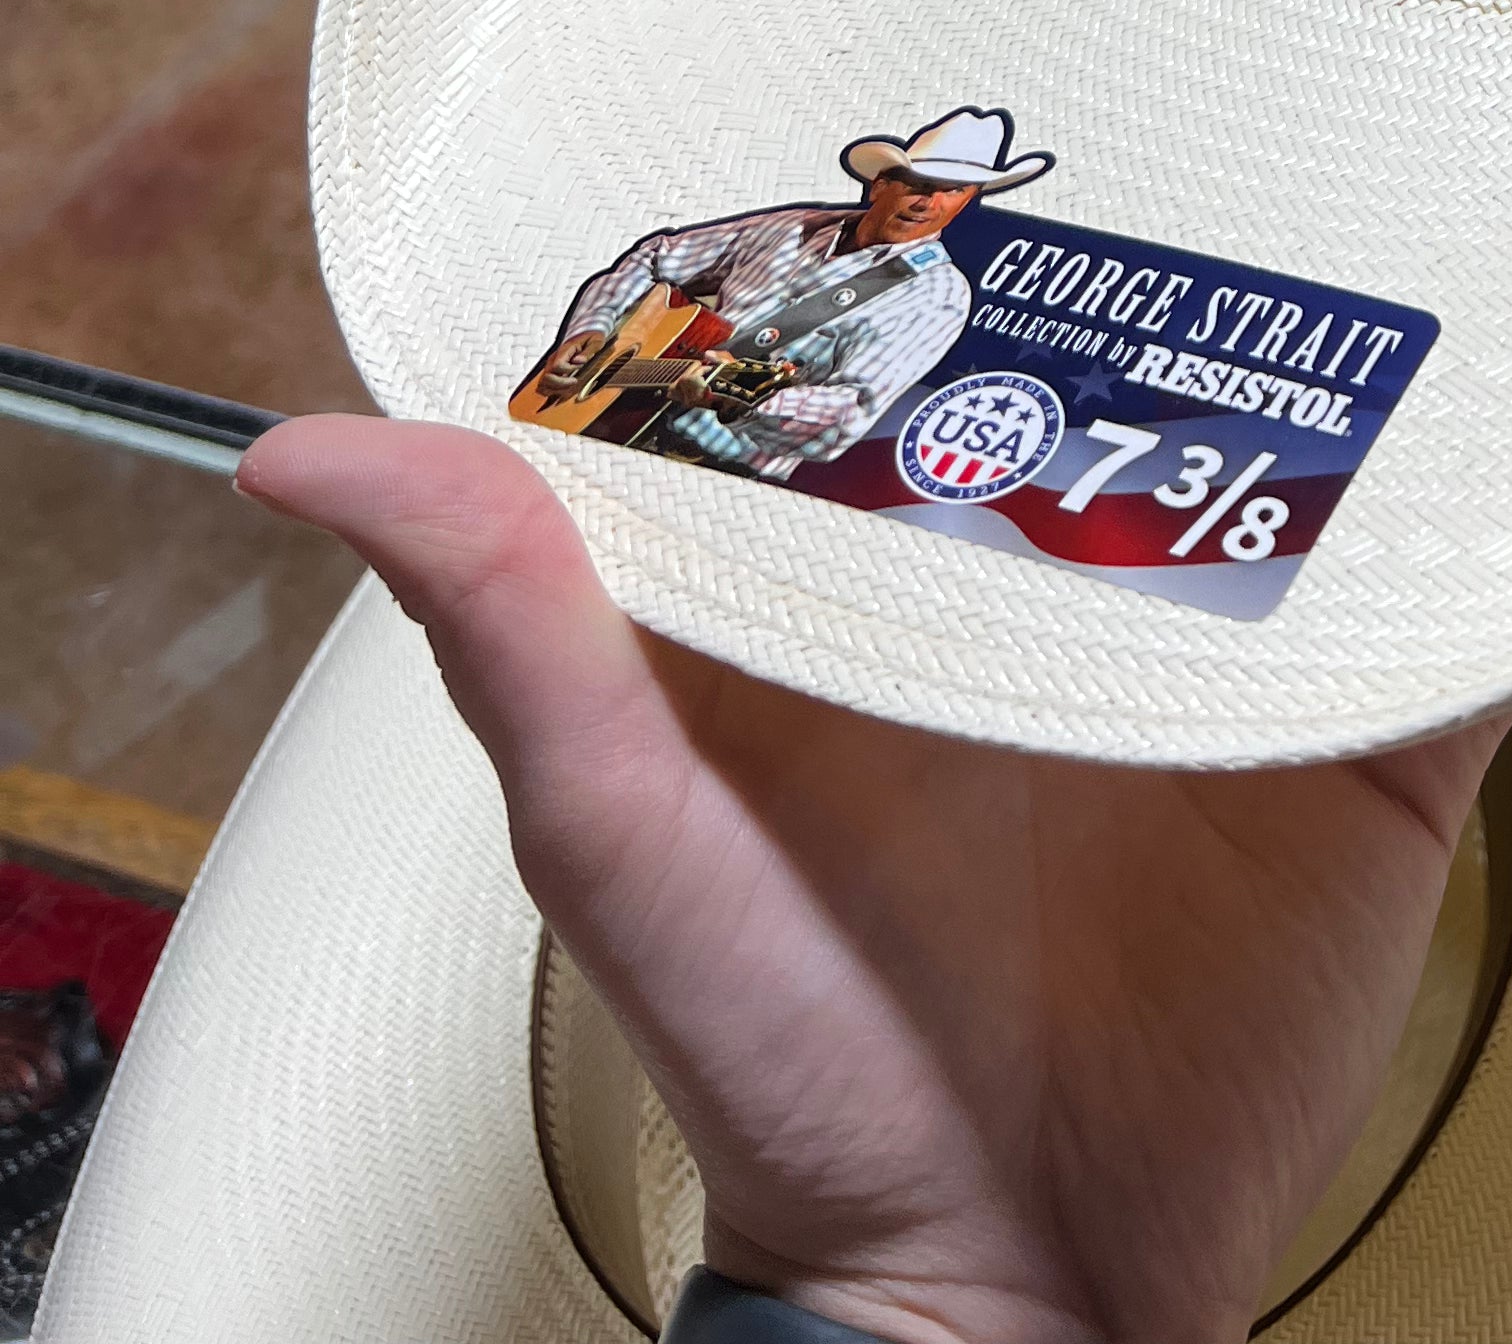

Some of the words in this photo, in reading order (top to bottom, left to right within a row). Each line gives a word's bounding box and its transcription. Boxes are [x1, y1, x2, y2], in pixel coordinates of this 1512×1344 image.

[979, 238, 1194, 333] GEORGE
[1186, 286, 1404, 386] STRAIT
[972, 304, 1110, 358] COLLECTION
[1107, 337, 1138, 368] by
[1124, 342, 1353, 437] RESISTOL
[1001, 377, 1045, 399] MADE
[912, 377, 987, 427] PROUDLY
[1044, 404, 1058, 422] IN
[933, 409, 1024, 464] USA
[1032, 431, 1056, 462] THE
[905, 458, 944, 494] SINCE
[957, 481, 1001, 499] 1927
[1058, 419, 1162, 513] 7
[1153, 444, 1291, 562] 3/8
